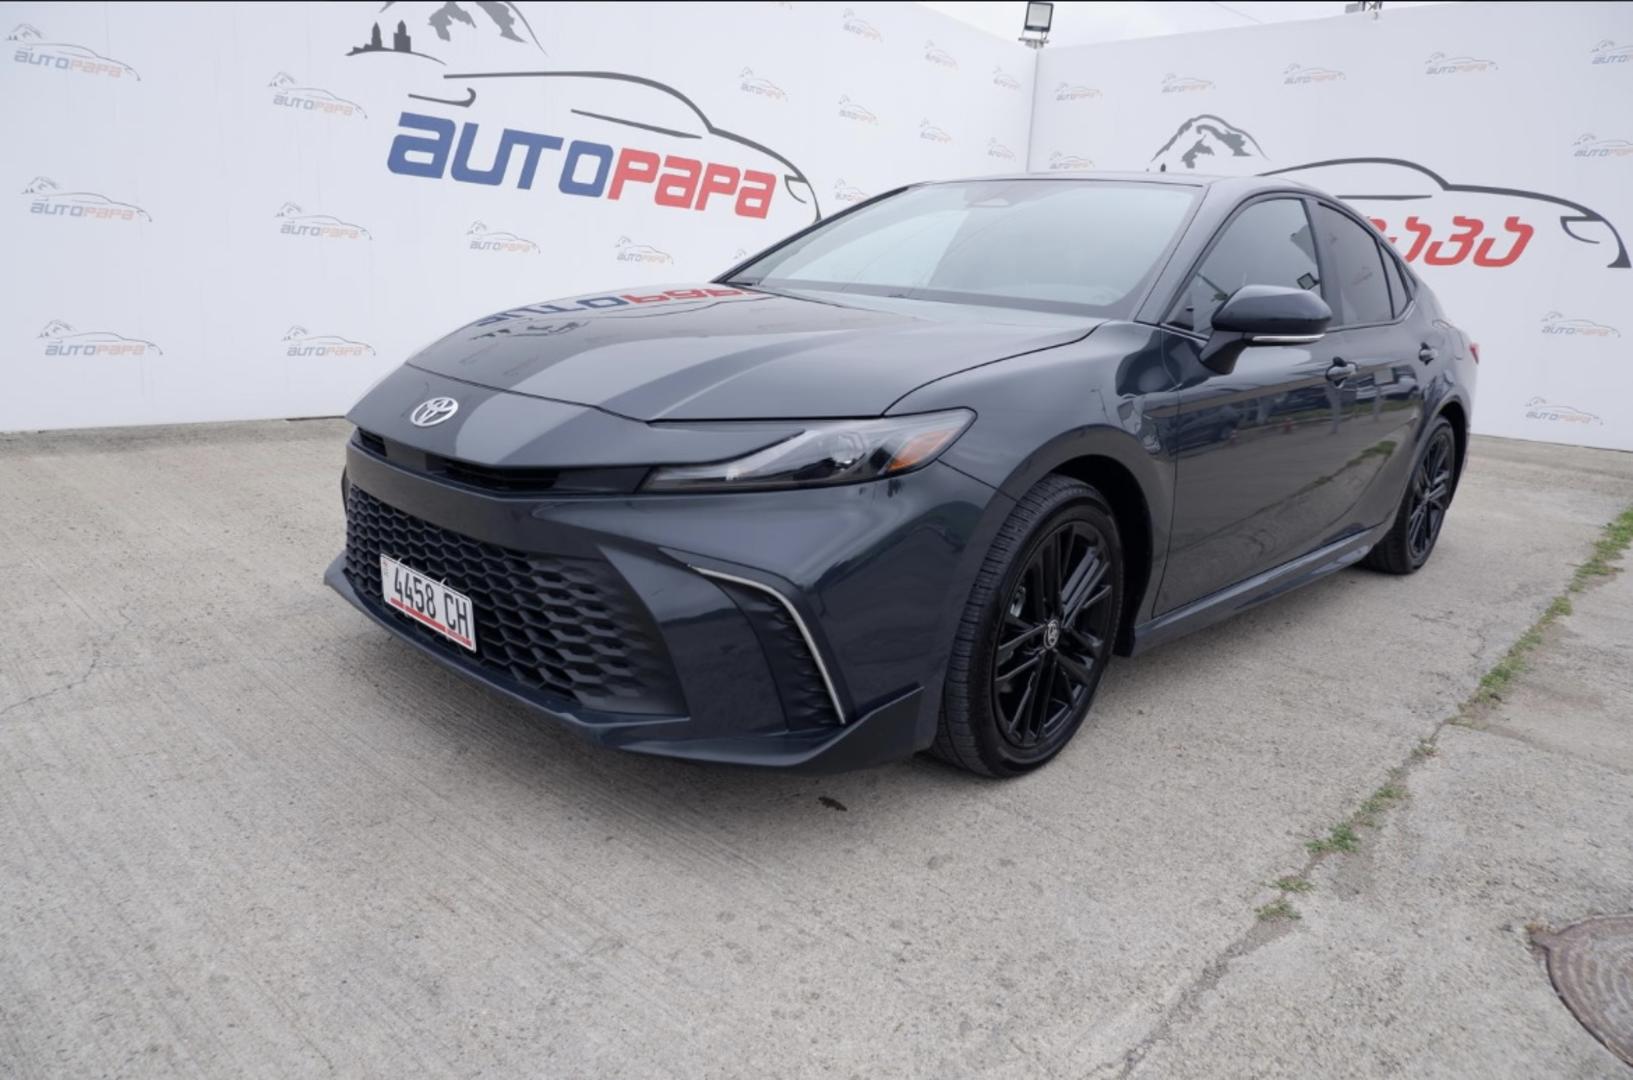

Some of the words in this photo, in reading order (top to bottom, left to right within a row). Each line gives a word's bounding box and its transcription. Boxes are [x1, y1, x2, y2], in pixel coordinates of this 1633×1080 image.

[387, 112, 777, 219] AUTOPAPA
[395, 567, 436, 619] 4458
[444, 593, 469, 637] CH
